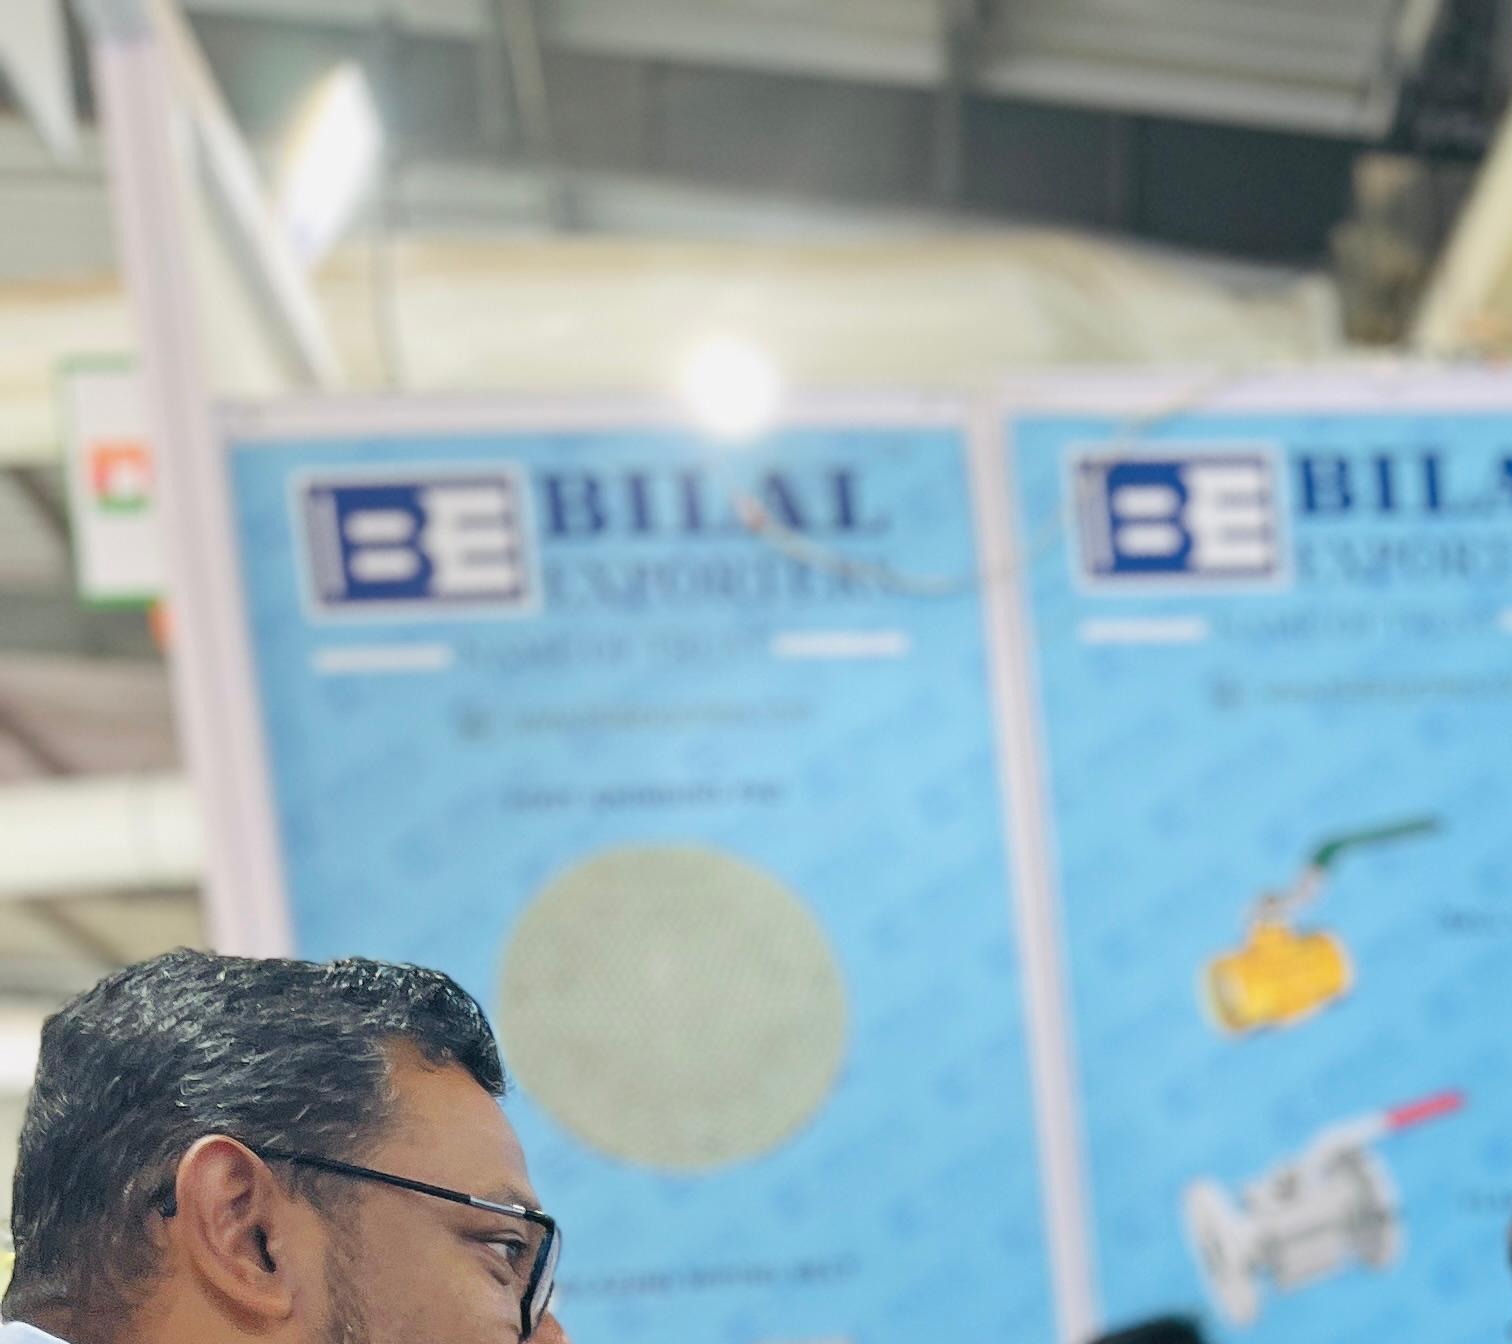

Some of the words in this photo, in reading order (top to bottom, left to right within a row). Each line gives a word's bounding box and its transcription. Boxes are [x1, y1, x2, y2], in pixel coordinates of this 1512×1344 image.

[320, 482, 515, 602] BE
[545, 466, 893, 538] BILAL
[1098, 460, 1270, 575] BE
